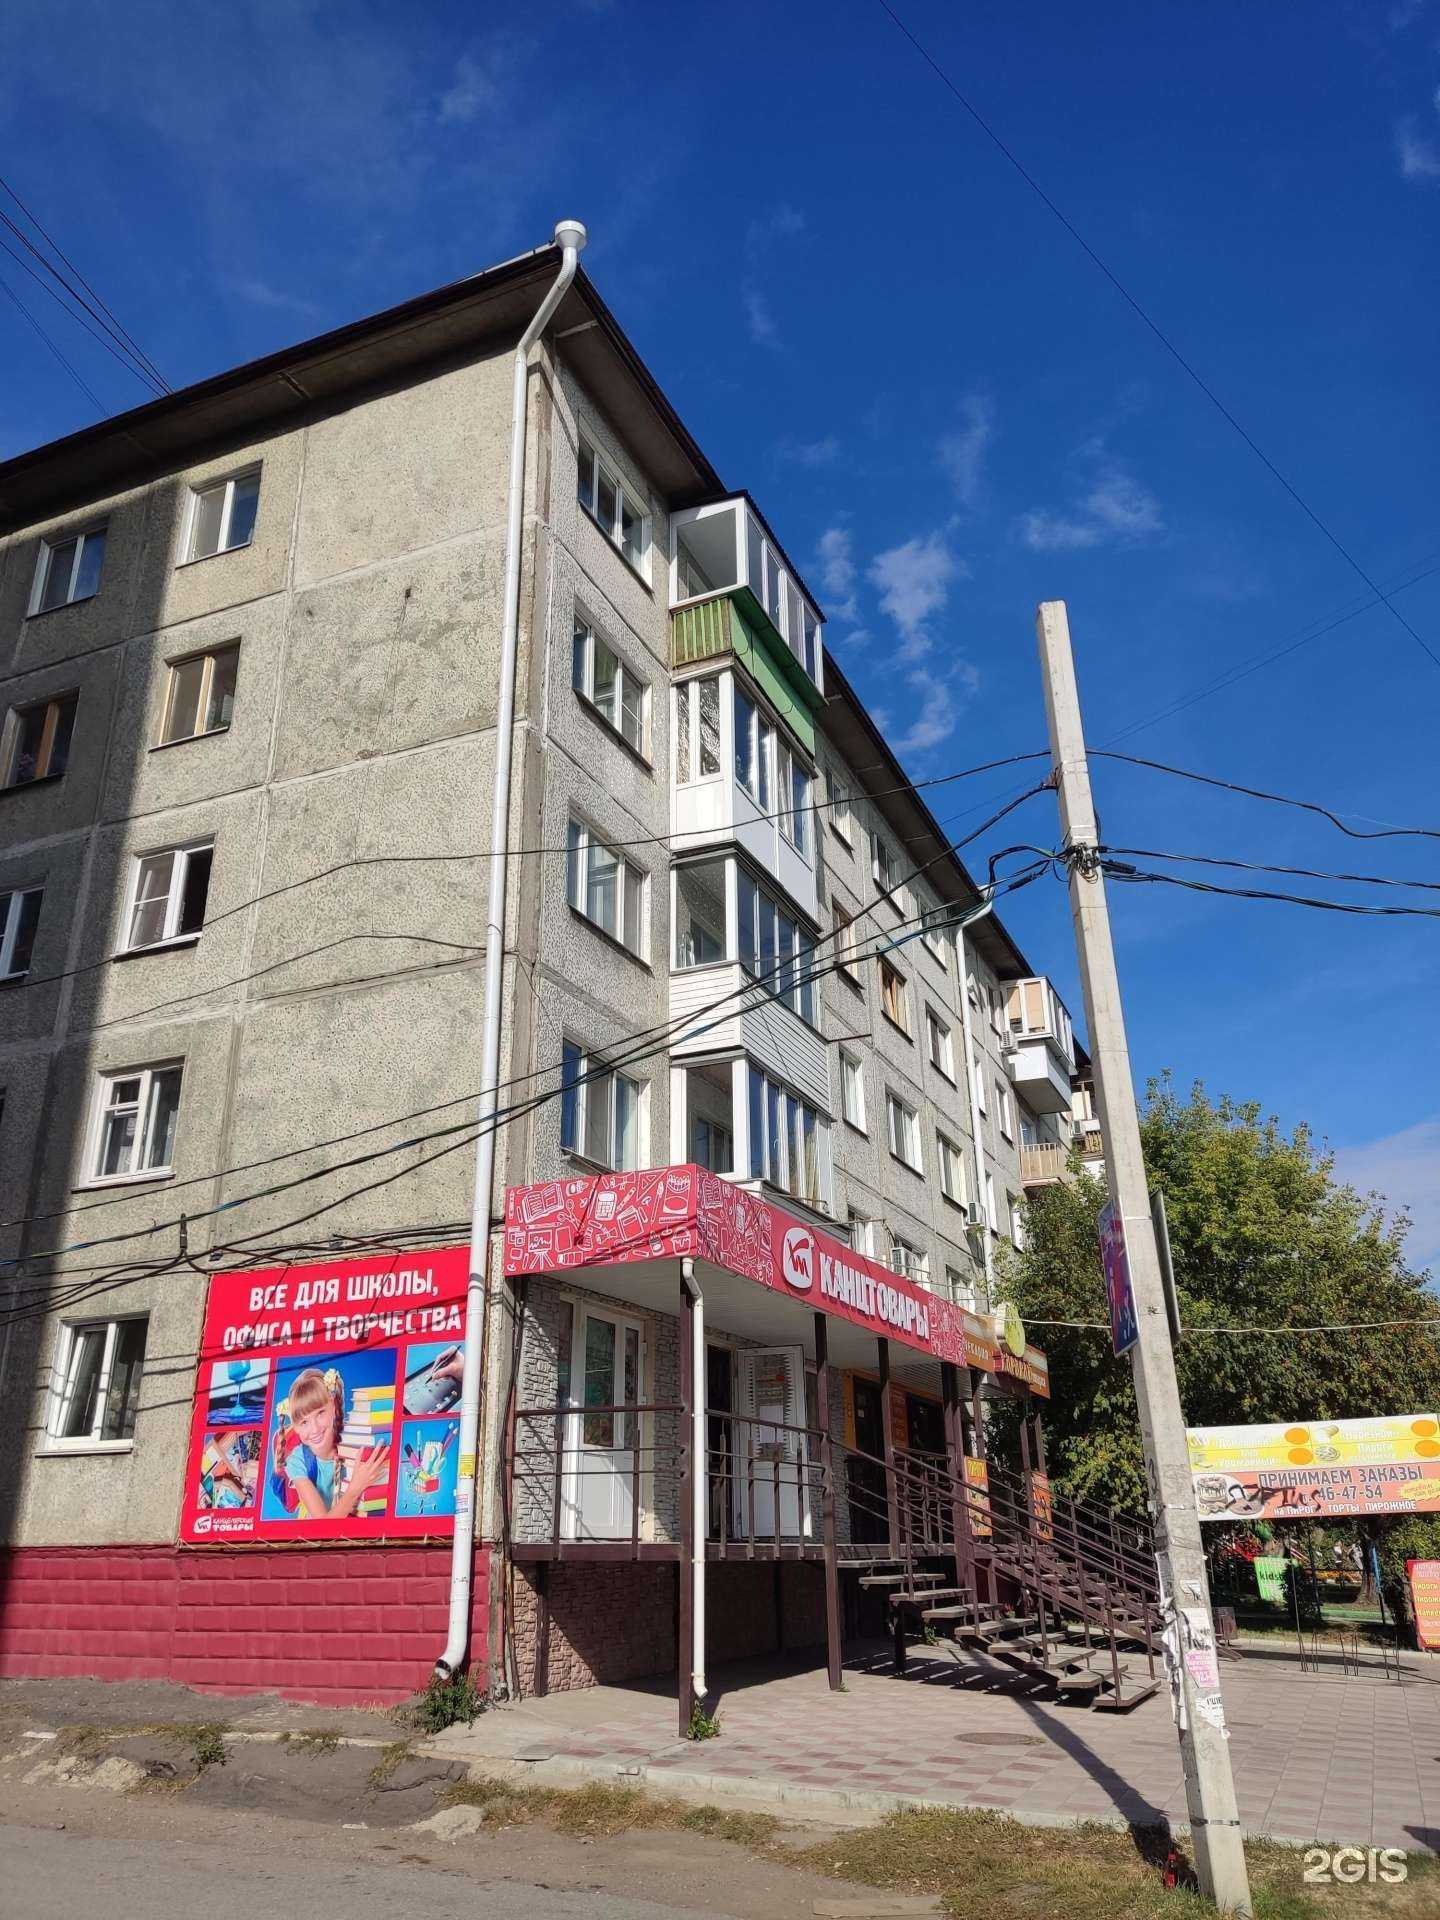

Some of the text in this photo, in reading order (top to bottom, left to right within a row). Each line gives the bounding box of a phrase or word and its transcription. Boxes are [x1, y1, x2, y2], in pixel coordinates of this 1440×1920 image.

[249, 1268, 439, 1312] ВСЕ ДЛЯ ШКОЛЫ,
[819, 1252, 930, 1340] КАНЦТОВАРЫ
[222, 1305, 462, 1351] ОФИСА И ТВОРЧЕСТВА
[1259, 1465, 1423, 1488] ПРИНИМАЕМ ЗАКАЗЫ
[1365, 1500, 1417, 1511] ПИРОЖНОЕ
[212, 1524, 255, 1532] ТОВАРЫ
